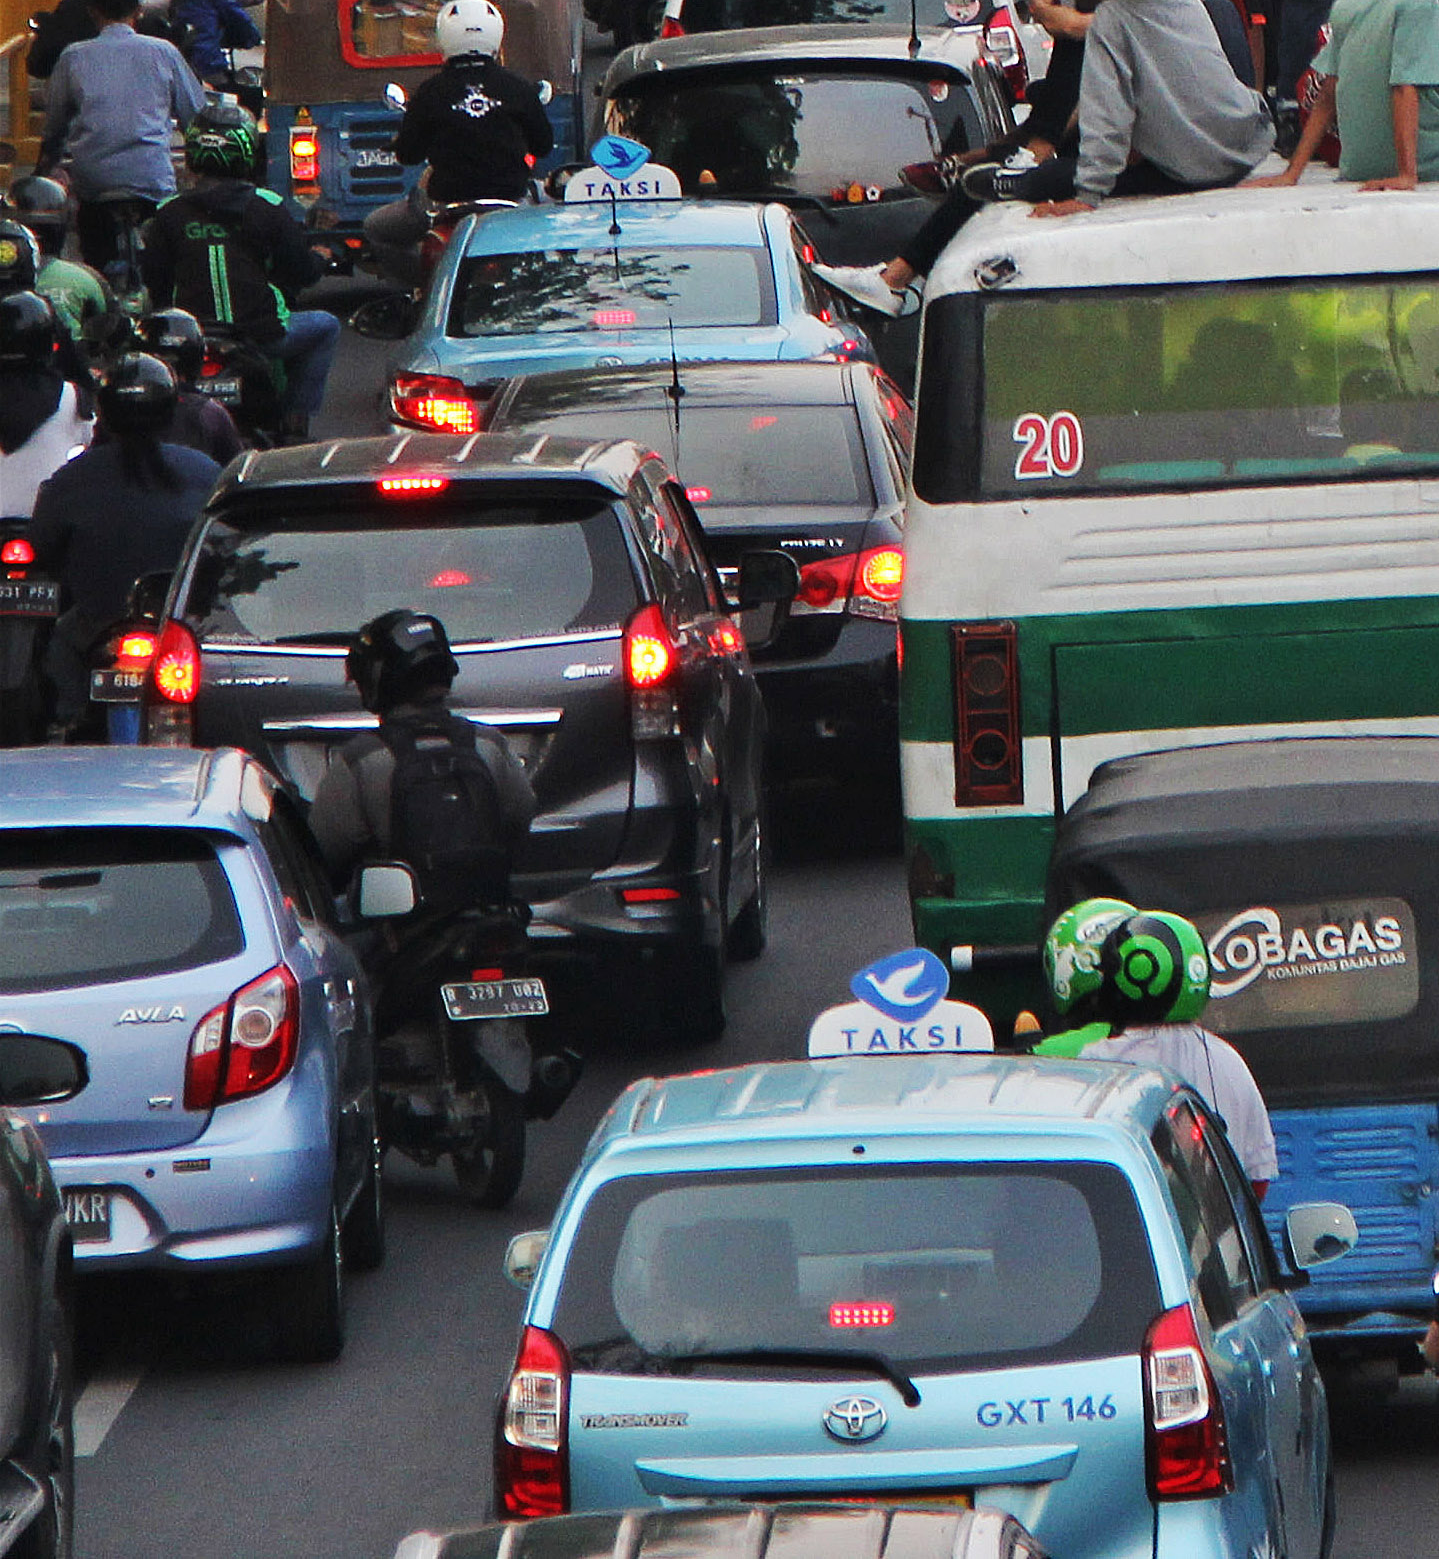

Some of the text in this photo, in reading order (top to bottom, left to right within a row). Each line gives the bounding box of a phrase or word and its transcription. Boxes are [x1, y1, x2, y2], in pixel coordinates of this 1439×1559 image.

[586, 180, 660, 197] TAKSI
[1013, 410, 1083, 480] 20
[1266, 952, 1406, 980] KOMUNITAS BAJAJ GAS
[842, 1025, 965, 1054] TAKSI
[580, 1413, 690, 1429] TRANSMOVER
[977, 1394, 1117, 1427] GXT 146
